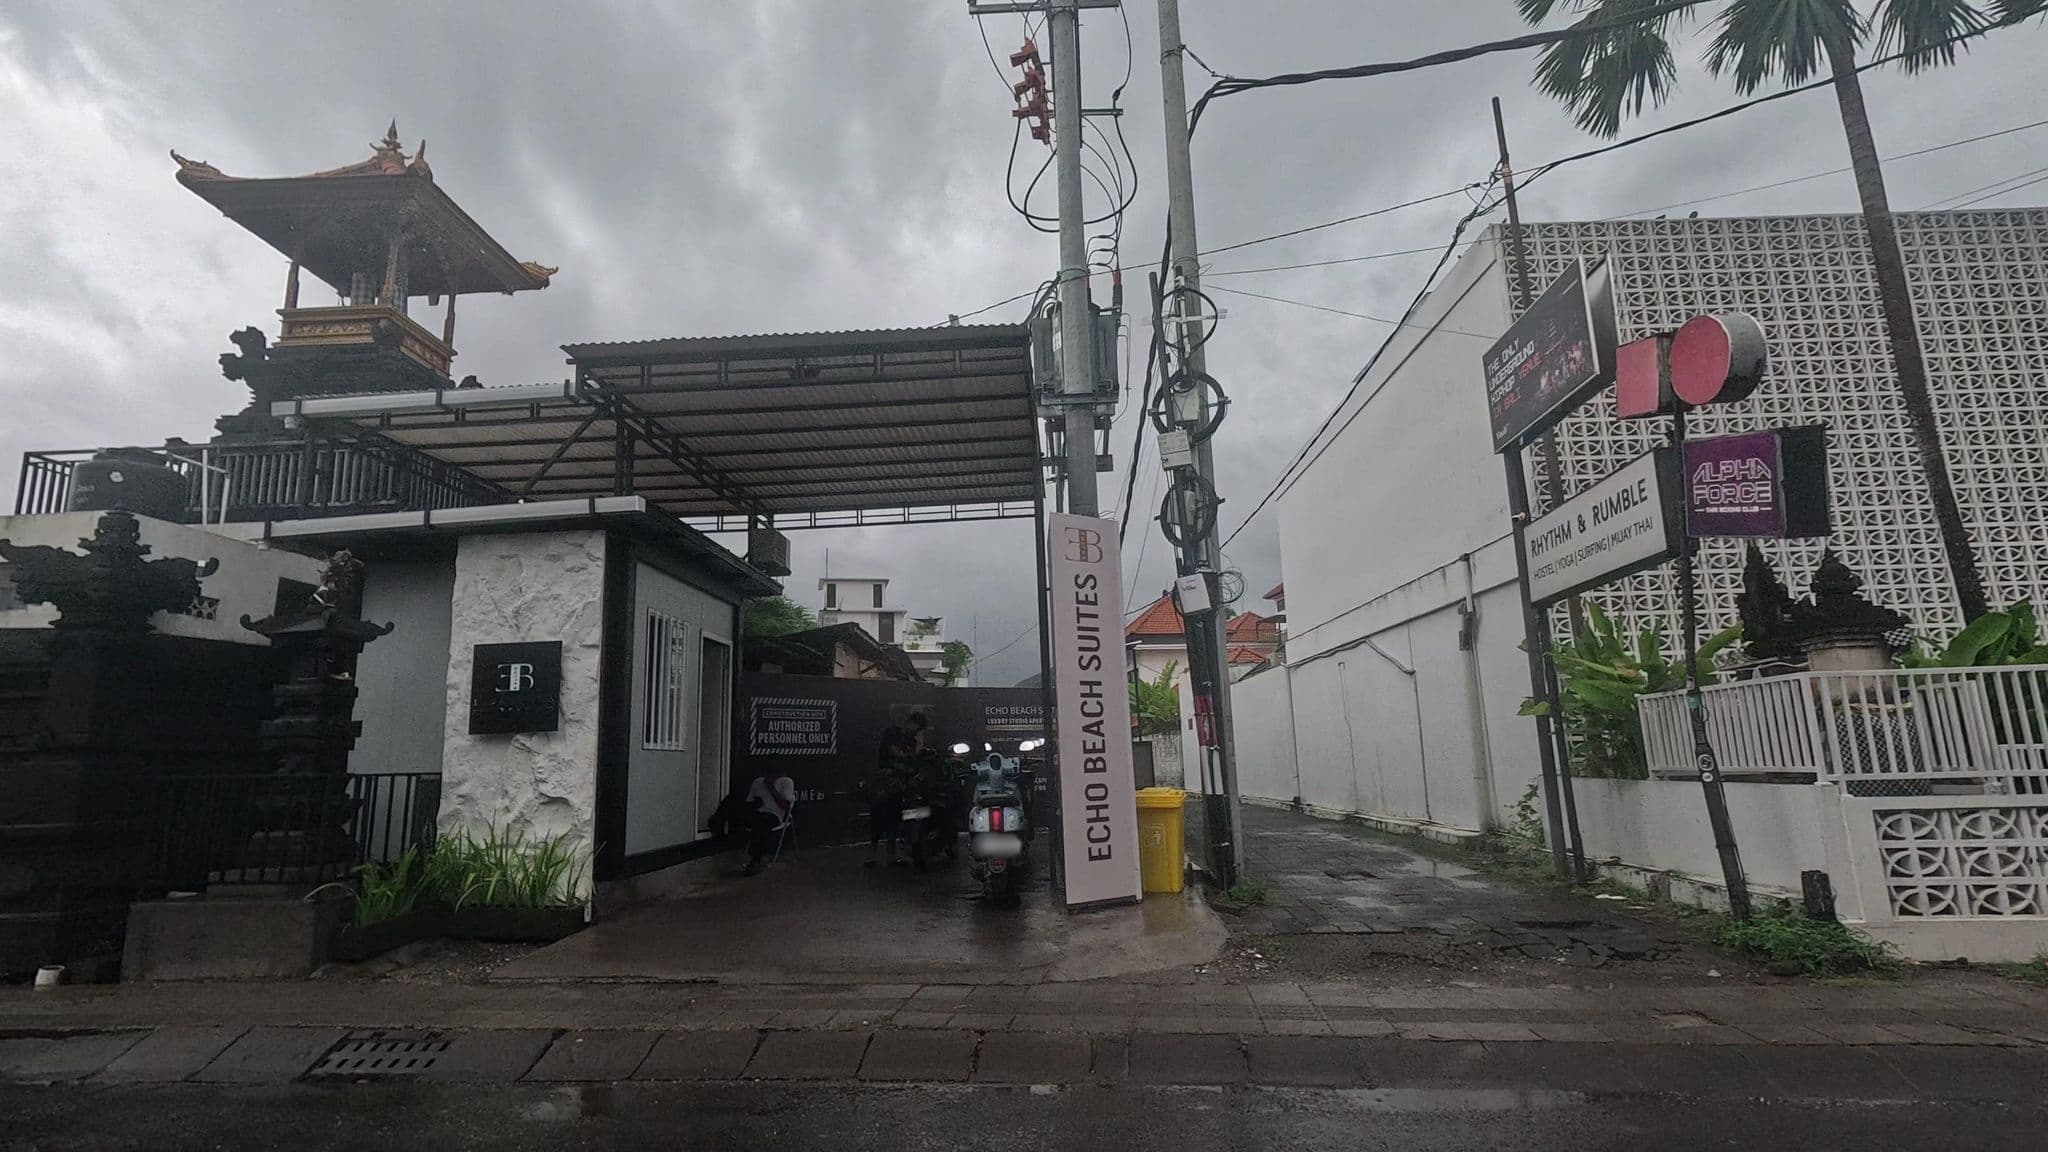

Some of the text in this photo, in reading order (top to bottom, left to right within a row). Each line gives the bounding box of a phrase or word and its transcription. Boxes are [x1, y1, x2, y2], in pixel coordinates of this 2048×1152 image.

[1488, 338, 1519, 376] THE ONLY
[1488, 340, 1535, 391] UNDERGROUND
[1518, 351, 1543, 381] VENUE
[1504, 386, 1521, 410] BALI
[1692, 457, 1772, 484] ALPHA
[1693, 481, 1773, 505] FORCE
[1531, 478, 1648, 558] RHYTHM & RUMBLE
[1578, 537, 1607, 562] SURFING
[1611, 528, 1632, 549] MUAY
[1634, 516, 1653, 537] THAI
[985, 706, 1009, 715] ECHO
[1010, 706, 1037, 715] BEACH
[1074, 573, 1112, 862] ECHO BEACH SUITES
[758, 731, 830, 744] PERSONNEL ONLY
[768, 720, 821, 732] AUTHORIZED
